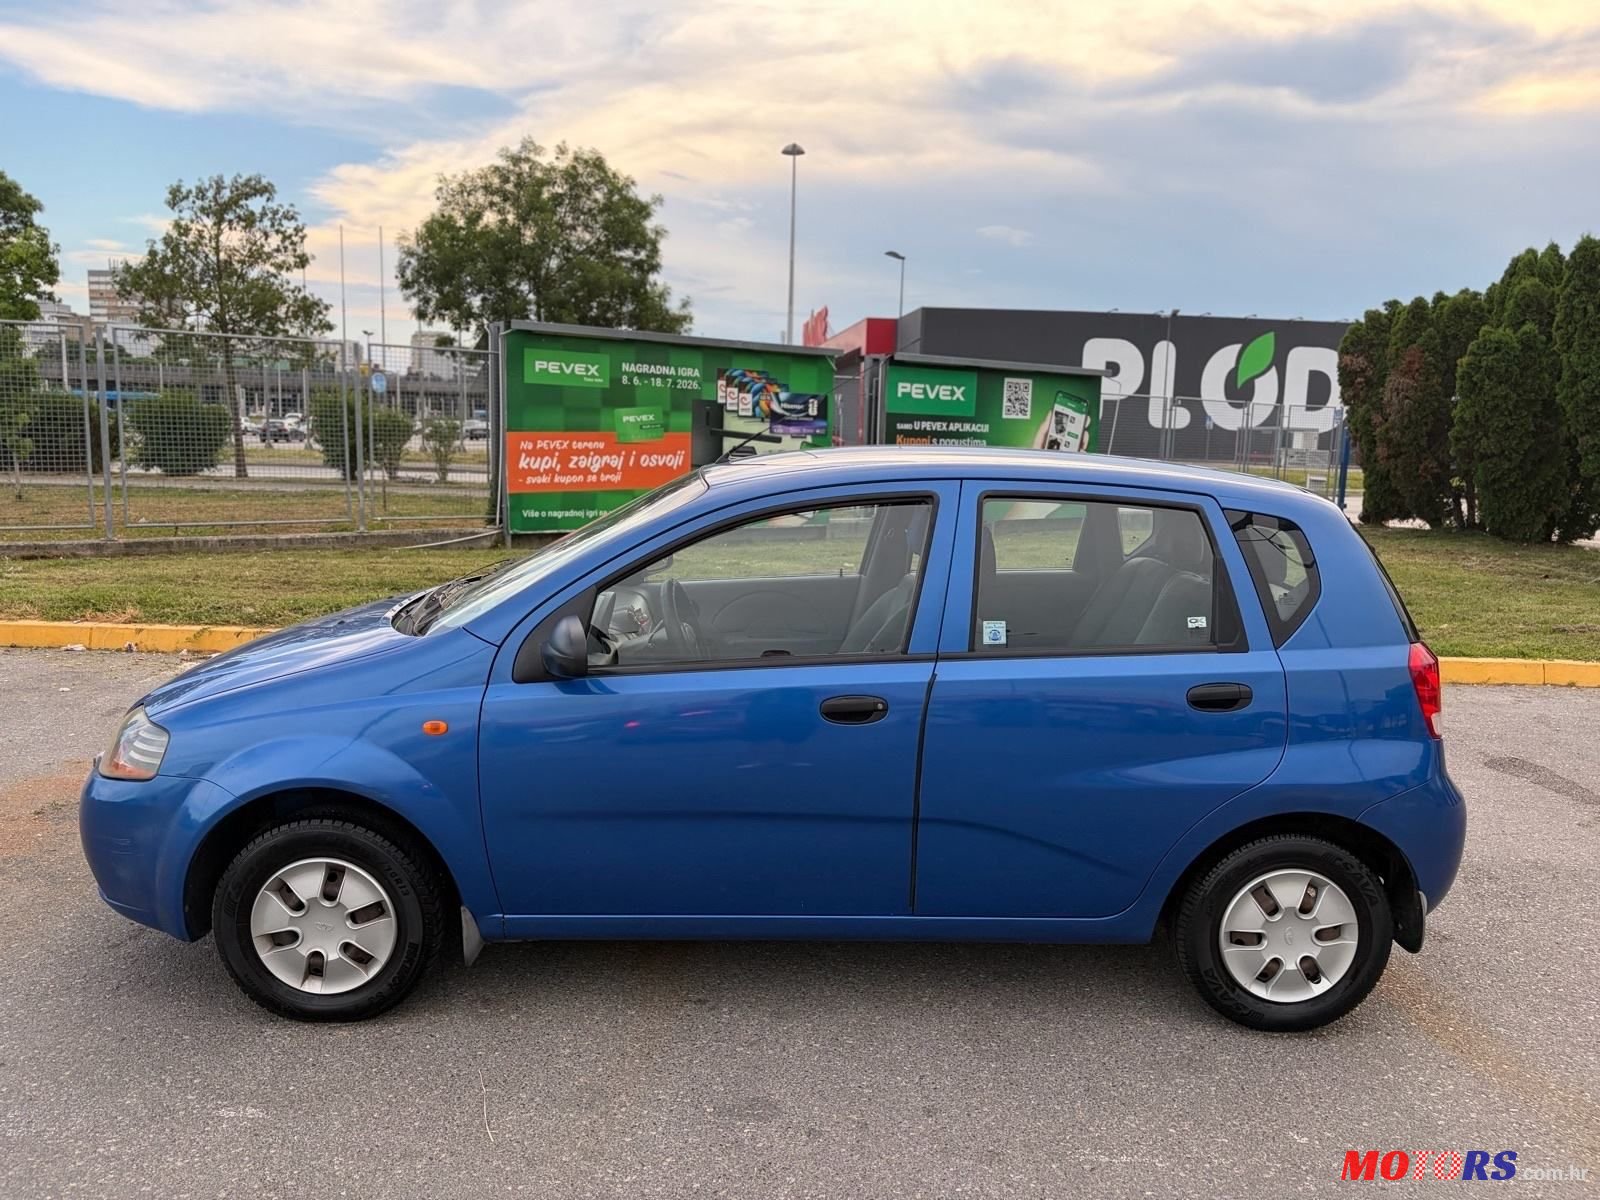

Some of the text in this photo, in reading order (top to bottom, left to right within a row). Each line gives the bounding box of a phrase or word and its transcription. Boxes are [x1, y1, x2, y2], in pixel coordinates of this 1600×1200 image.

[535, 360, 600, 376] PEVEX
[622, 362, 701, 378] NAGRADNA IGRA
[622, 375, 632, 386] 8.
[634, 376, 643, 386] 6.
[651, 377, 665, 387] 18.
[666, 378, 675, 388] 7.
[676, 378, 702, 390] 2026.
[897, 382, 966, 401] PEVEX
[622, 413, 655, 424] PEVEX
[914, 421, 921, 430] U
[921, 421, 947, 432] PEVEX
[948, 422, 990, 433] APLIKACIJI
[520, 439, 605, 450] Na PEVEX terenu
[519, 450, 685, 473] kupi, zaigraj i osvoji
[526, 473, 551, 484] svaki
[554, 473, 584, 485] kupon
[587, 475, 598, 484] se
[522, 508, 539, 518] Više
[548, 509, 585, 520] nagradnoj
